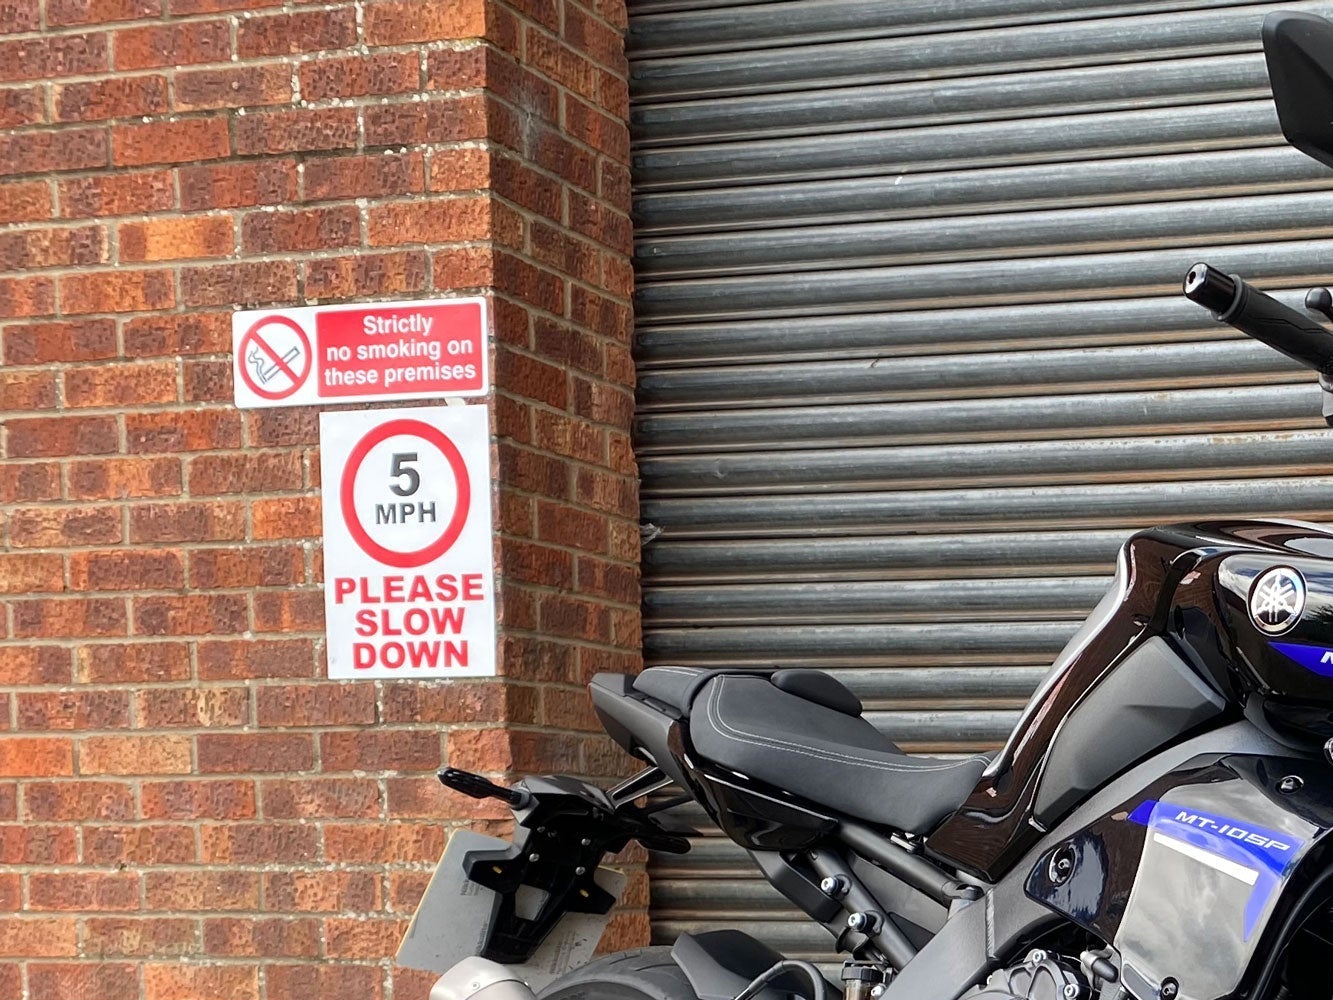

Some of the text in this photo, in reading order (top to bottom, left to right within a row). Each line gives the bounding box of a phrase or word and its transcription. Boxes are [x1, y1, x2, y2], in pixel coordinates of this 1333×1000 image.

[363, 315, 433, 336] Strictly
[326, 339, 473, 362] no smoking on
[324, 362, 476, 388] these premises
[388, 451, 421, 497] 5
[375, 502, 437, 525] MPH
[334, 573, 485, 604] PLEASE
[355, 607, 466, 637] SLOW
[352, 640, 469, 670] DOWN
